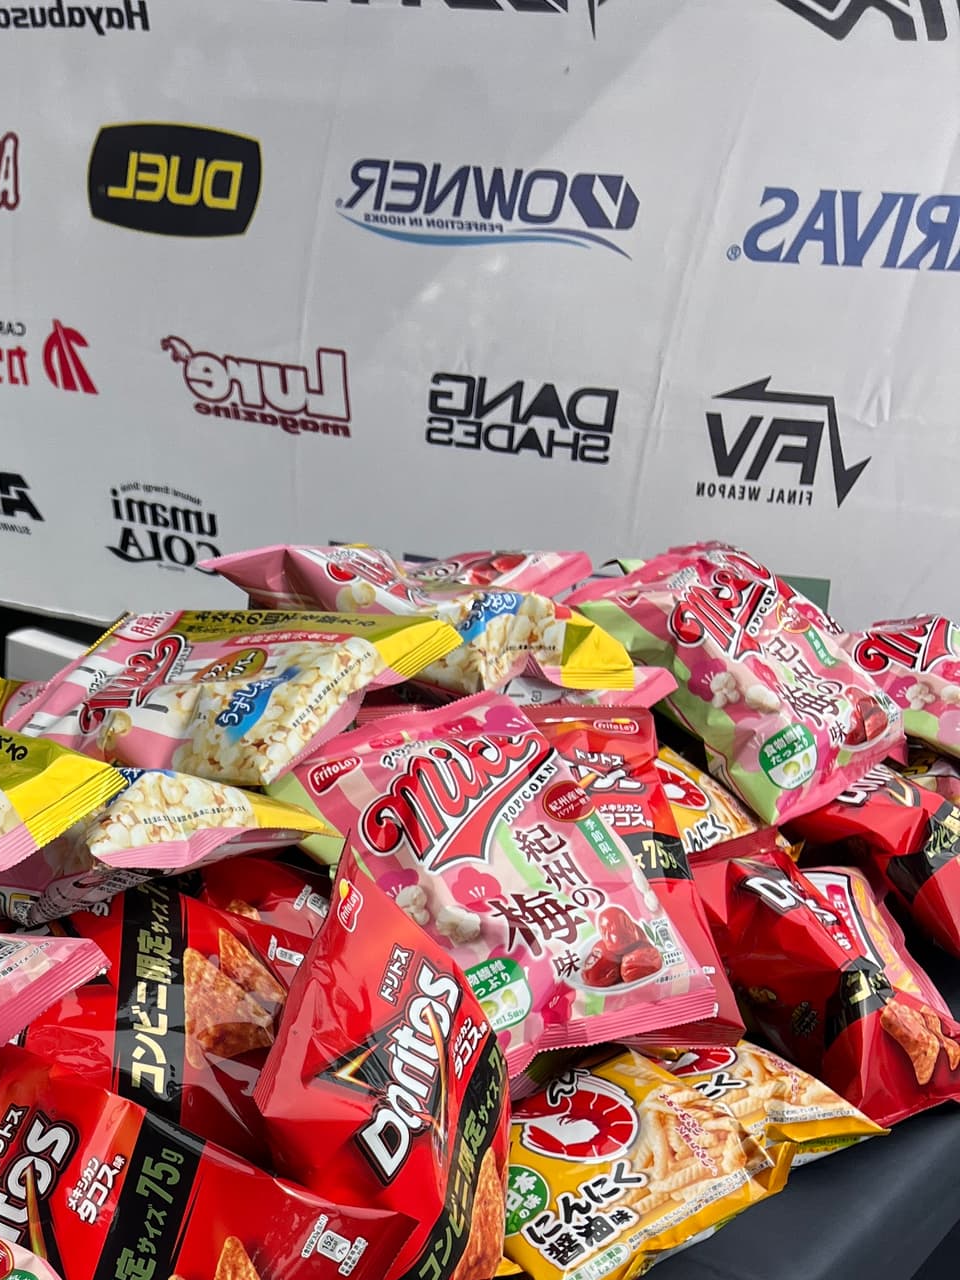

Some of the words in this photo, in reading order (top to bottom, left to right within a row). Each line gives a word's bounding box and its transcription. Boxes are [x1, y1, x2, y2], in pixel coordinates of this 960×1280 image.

[513, 824, 606, 910] 紀州の
[379, 944, 414, 1004] ドリトス
[356, 959, 462, 1186] Doritos
[67, 1157, 100, 1211] メキシカン
[136, 1148, 185, 1205] 75g
[526, 1162, 642, 1245] にんにく
[321, 1234, 335, 1250] 152
